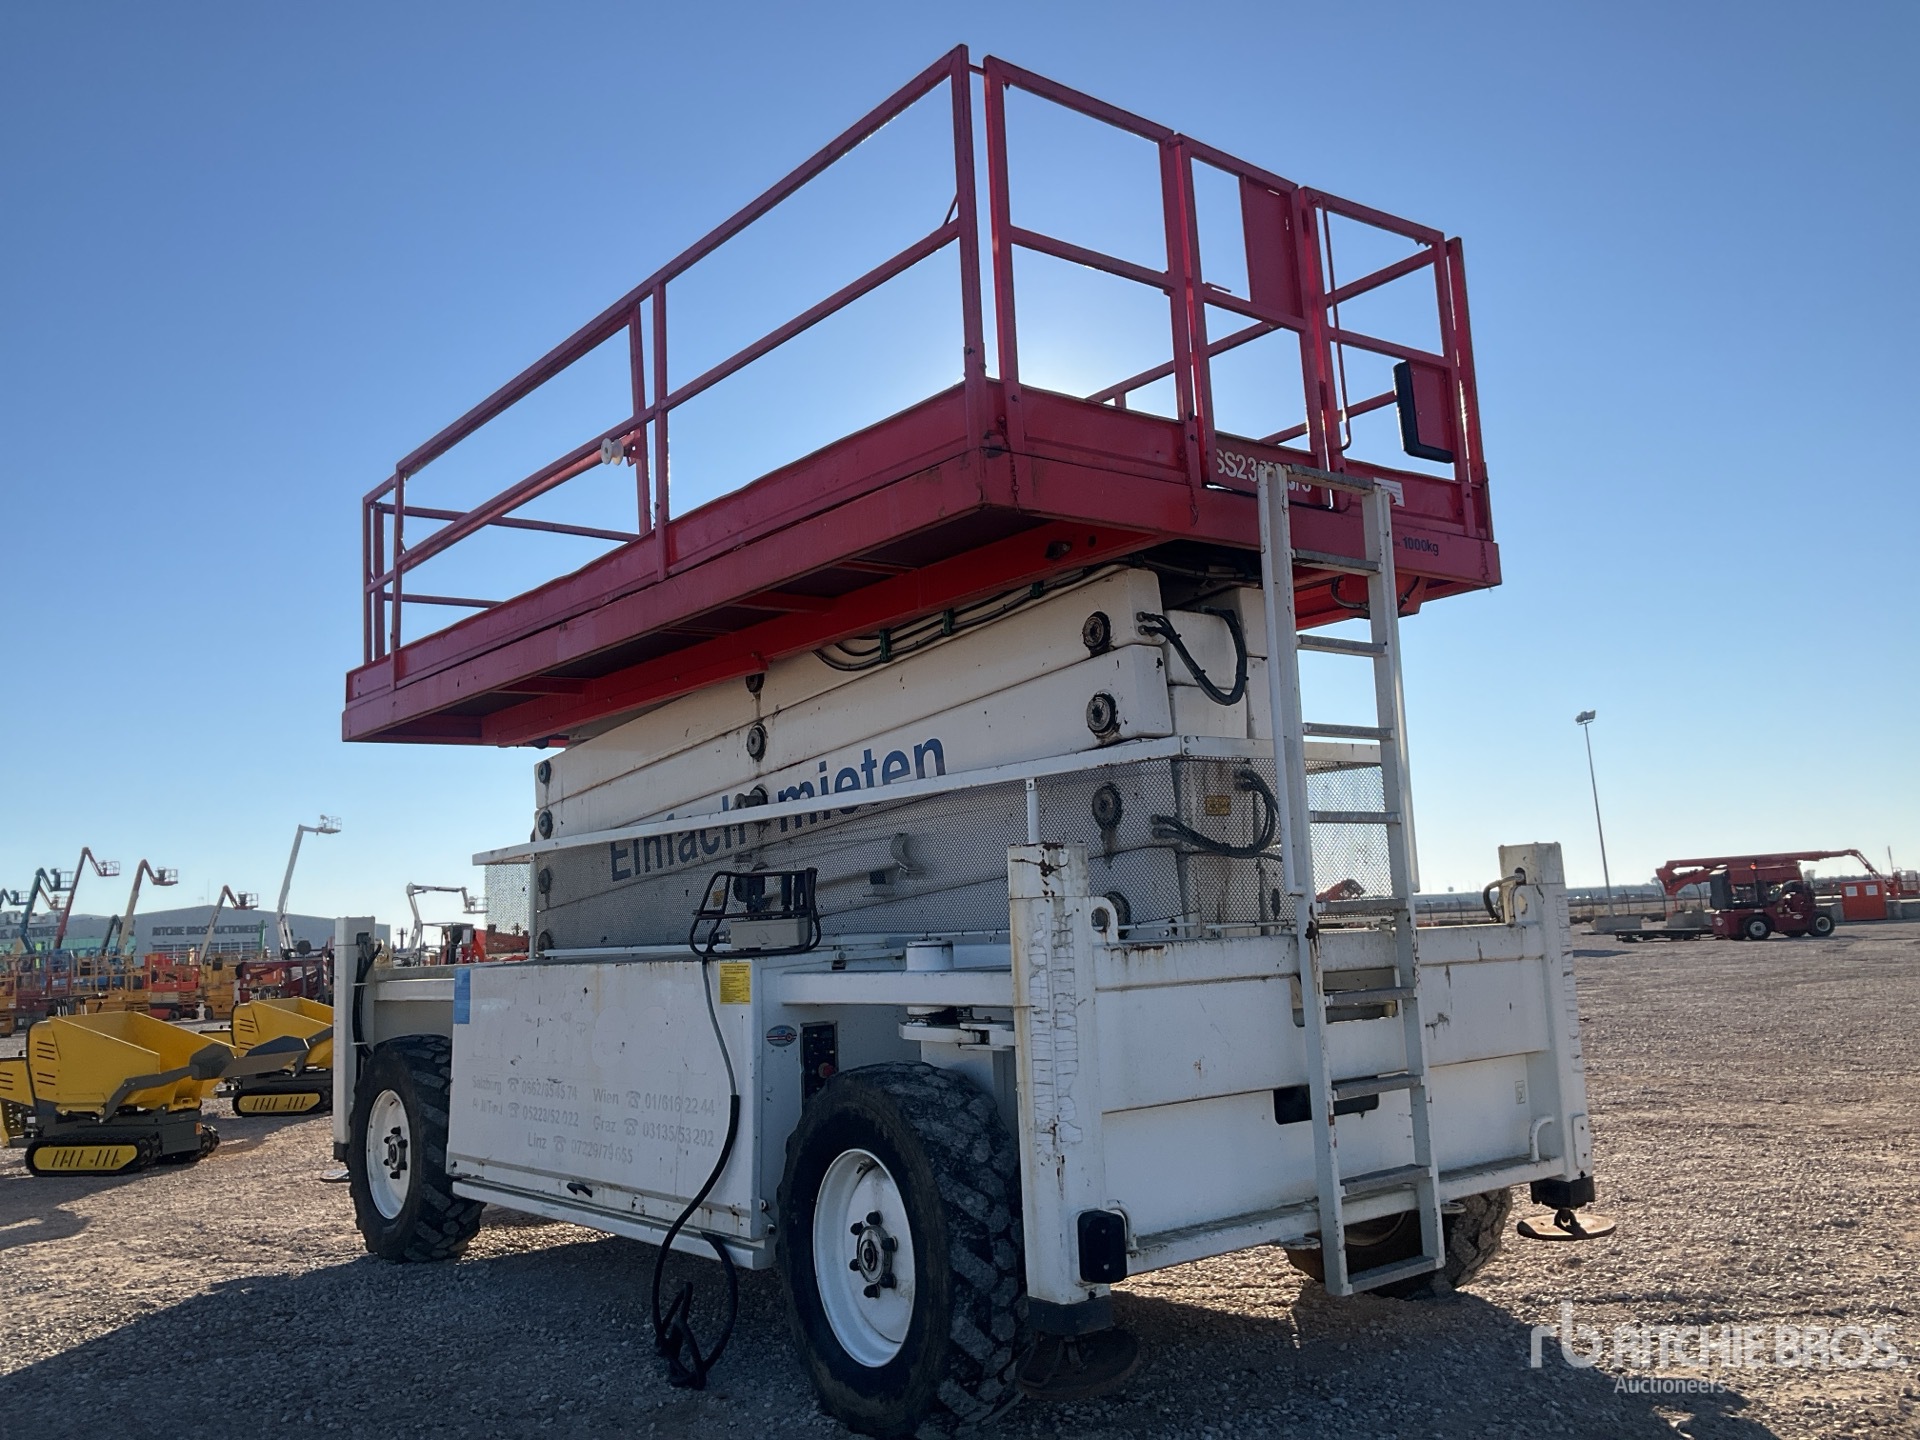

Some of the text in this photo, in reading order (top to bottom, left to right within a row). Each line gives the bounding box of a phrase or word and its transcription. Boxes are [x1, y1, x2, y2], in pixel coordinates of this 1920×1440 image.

[1403, 536, 1439, 556] 1000kg
[778, 738, 947, 832] mieten
[593, 1088, 619, 1105] Wien
[684, 1096, 699, 1114] 22
[593, 1115, 617, 1133] Graz
[527, 1131, 548, 1150] Linz
